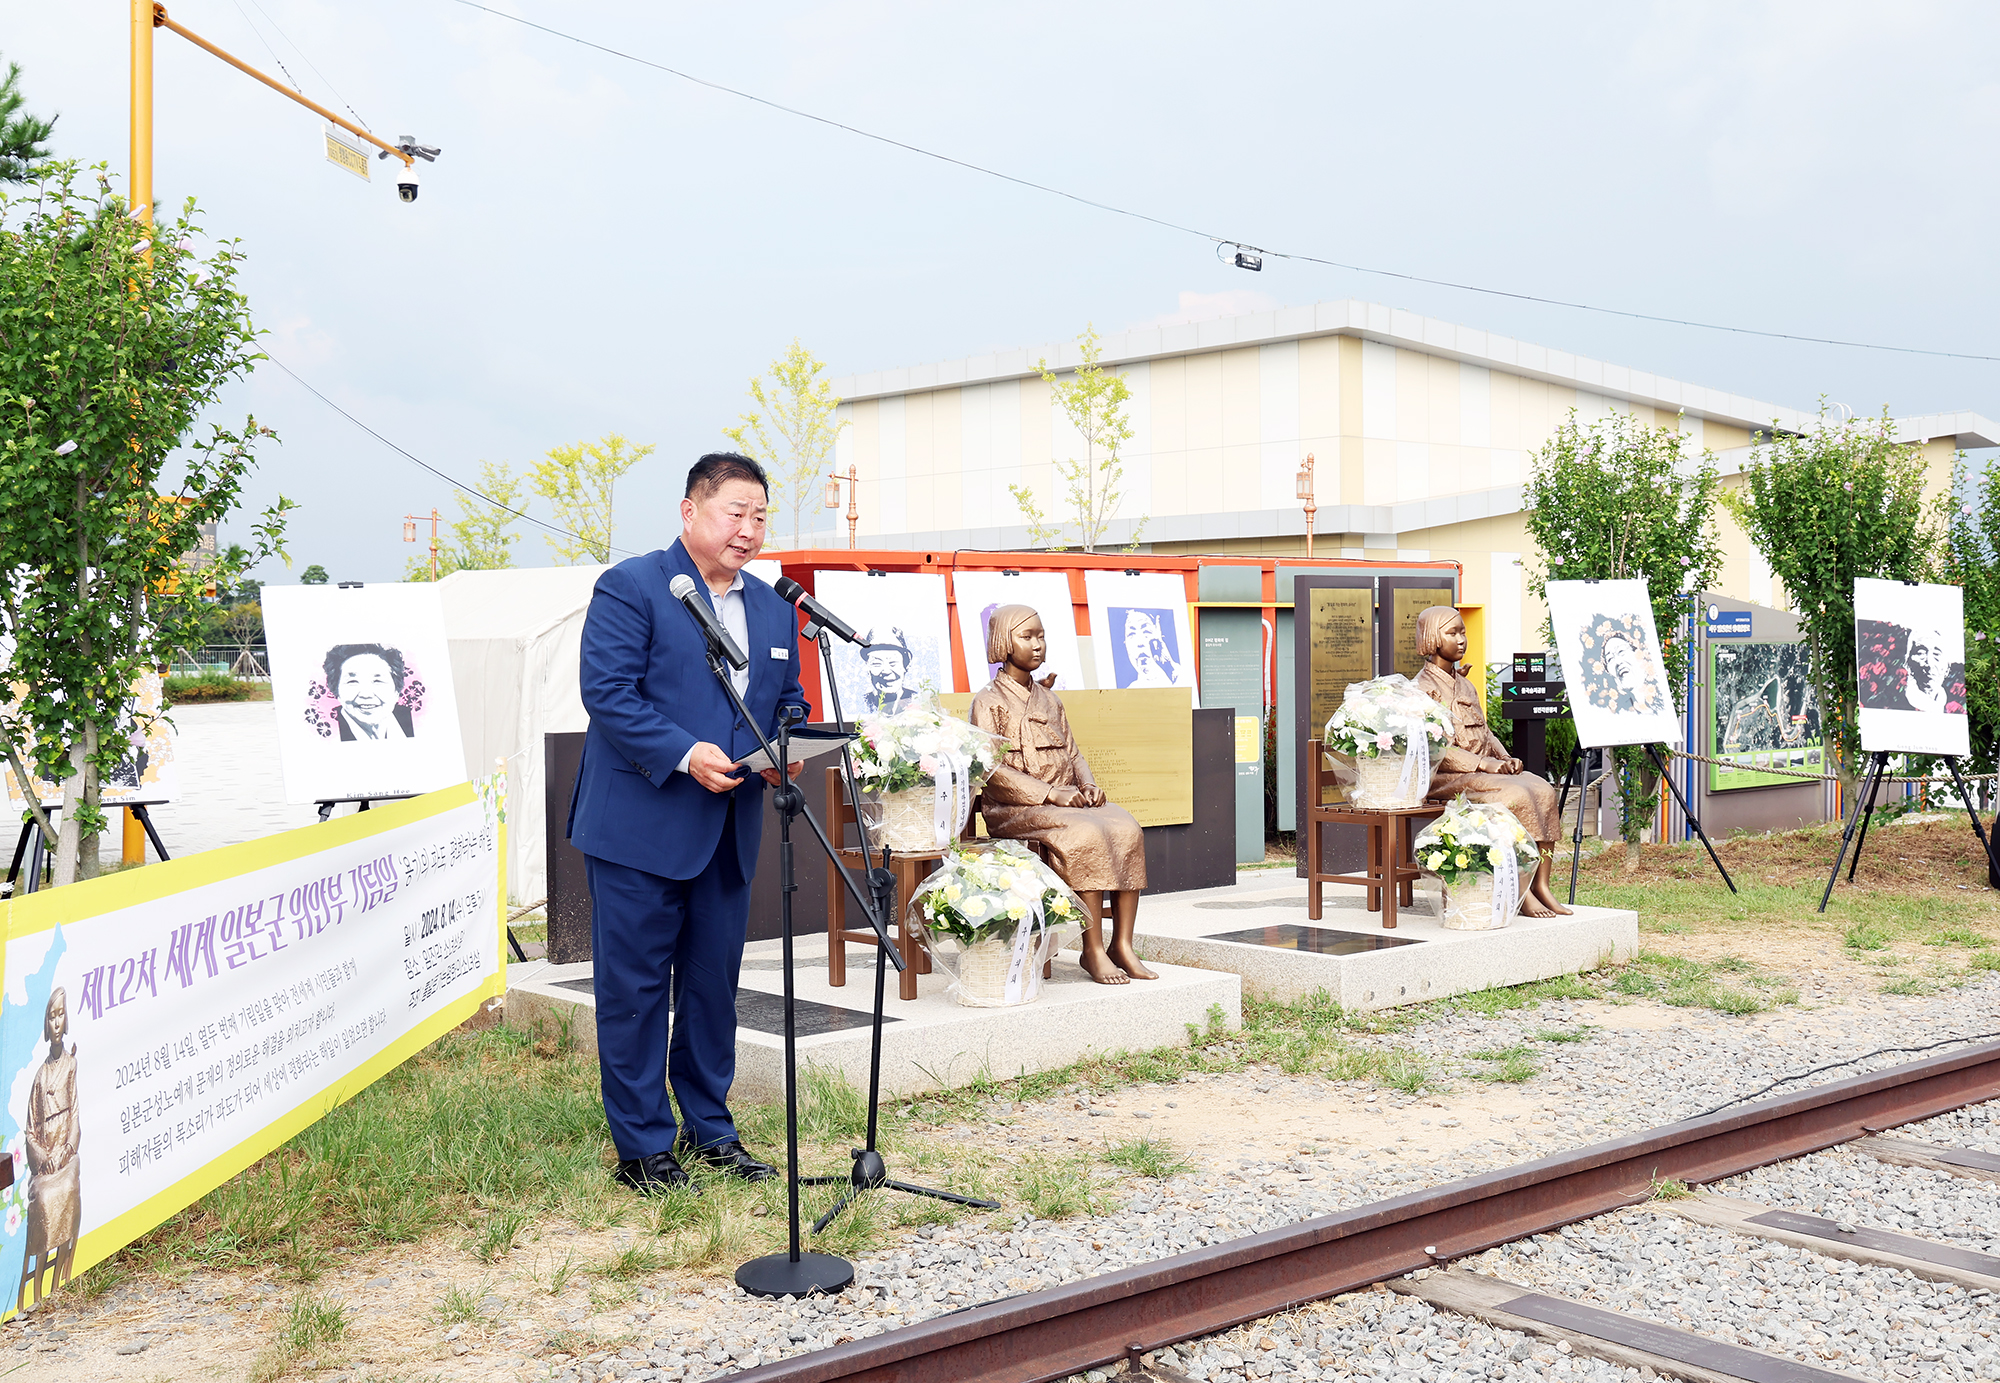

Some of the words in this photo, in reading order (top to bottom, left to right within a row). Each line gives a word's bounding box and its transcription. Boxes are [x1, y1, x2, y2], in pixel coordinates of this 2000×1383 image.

[77, 946, 158, 1021] 제12차
[164, 914, 218, 989] 세계
[220, 892, 288, 970] 일본군
[288, 872, 348, 941] 위안부
[347, 853, 399, 914] 기림일
[115, 1052, 152, 1090] 2024년
[154, 1043, 172, 1071] 8월
[173, 1032, 199, 1062] 14일,
[198, 1023, 218, 1050] 열두
[218, 1012, 239, 1040] 번째
[238, 998, 274, 1030] 기림일을
[272, 989, 292, 1015] 맞아
[289, 977, 316, 1006] 전세계
[314, 964, 344, 993] 시민들과
[342, 957, 358, 981] 함께
[118, 1126, 173, 1177] 피해자들의
[175, 1104, 214, 1146] 목소리가
[216, 1088, 243, 1122] 파도가
[243, 1077, 263, 1105] 되어
[263, 1063, 289, 1094] 세상에
[288, 1049, 320, 1081] 평화라는
[318, 1033, 342, 1061] 해일이
[342, 1018, 368, 1050] 일었으면
[368, 1007, 388, 1035] 합니다.
[120, 1075, 194, 1135] 일본군성노예제
[196, 1060, 223, 1096] 문제의
[226, 1044, 260, 1079] 정의로운
[262, 1030, 286, 1059] 해결을
[286, 1013, 315, 1046] 외치고자
[315, 1001, 336, 1030] 합니다.
